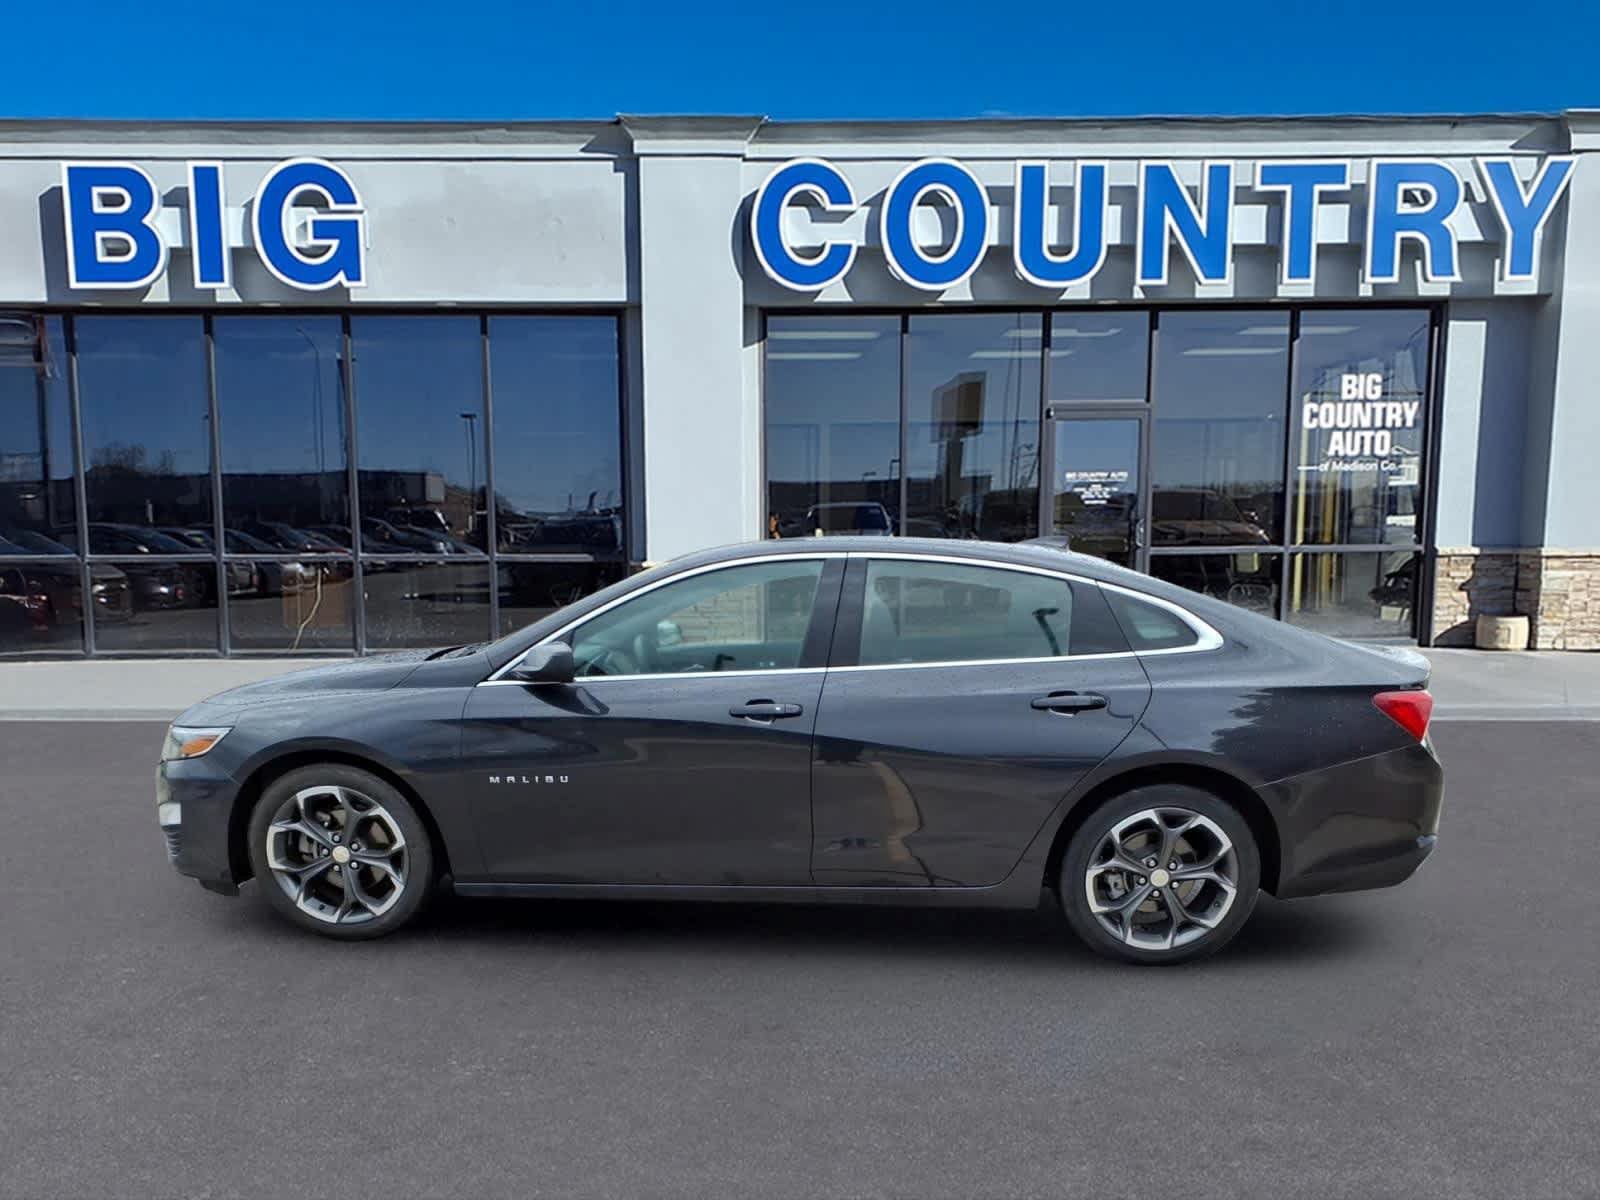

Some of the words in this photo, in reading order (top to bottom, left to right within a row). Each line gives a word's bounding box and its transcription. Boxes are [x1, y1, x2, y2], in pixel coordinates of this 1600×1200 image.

[61, 157, 366, 291] BIG
[750, 157, 1577, 291] COUNTRY
[1341, 373, 1382, 401] BIG
[1302, 401, 1419, 429] COUNTRY
[1327, 429, 1392, 457] AUTO
[489, 775, 569, 784] MALIBU
